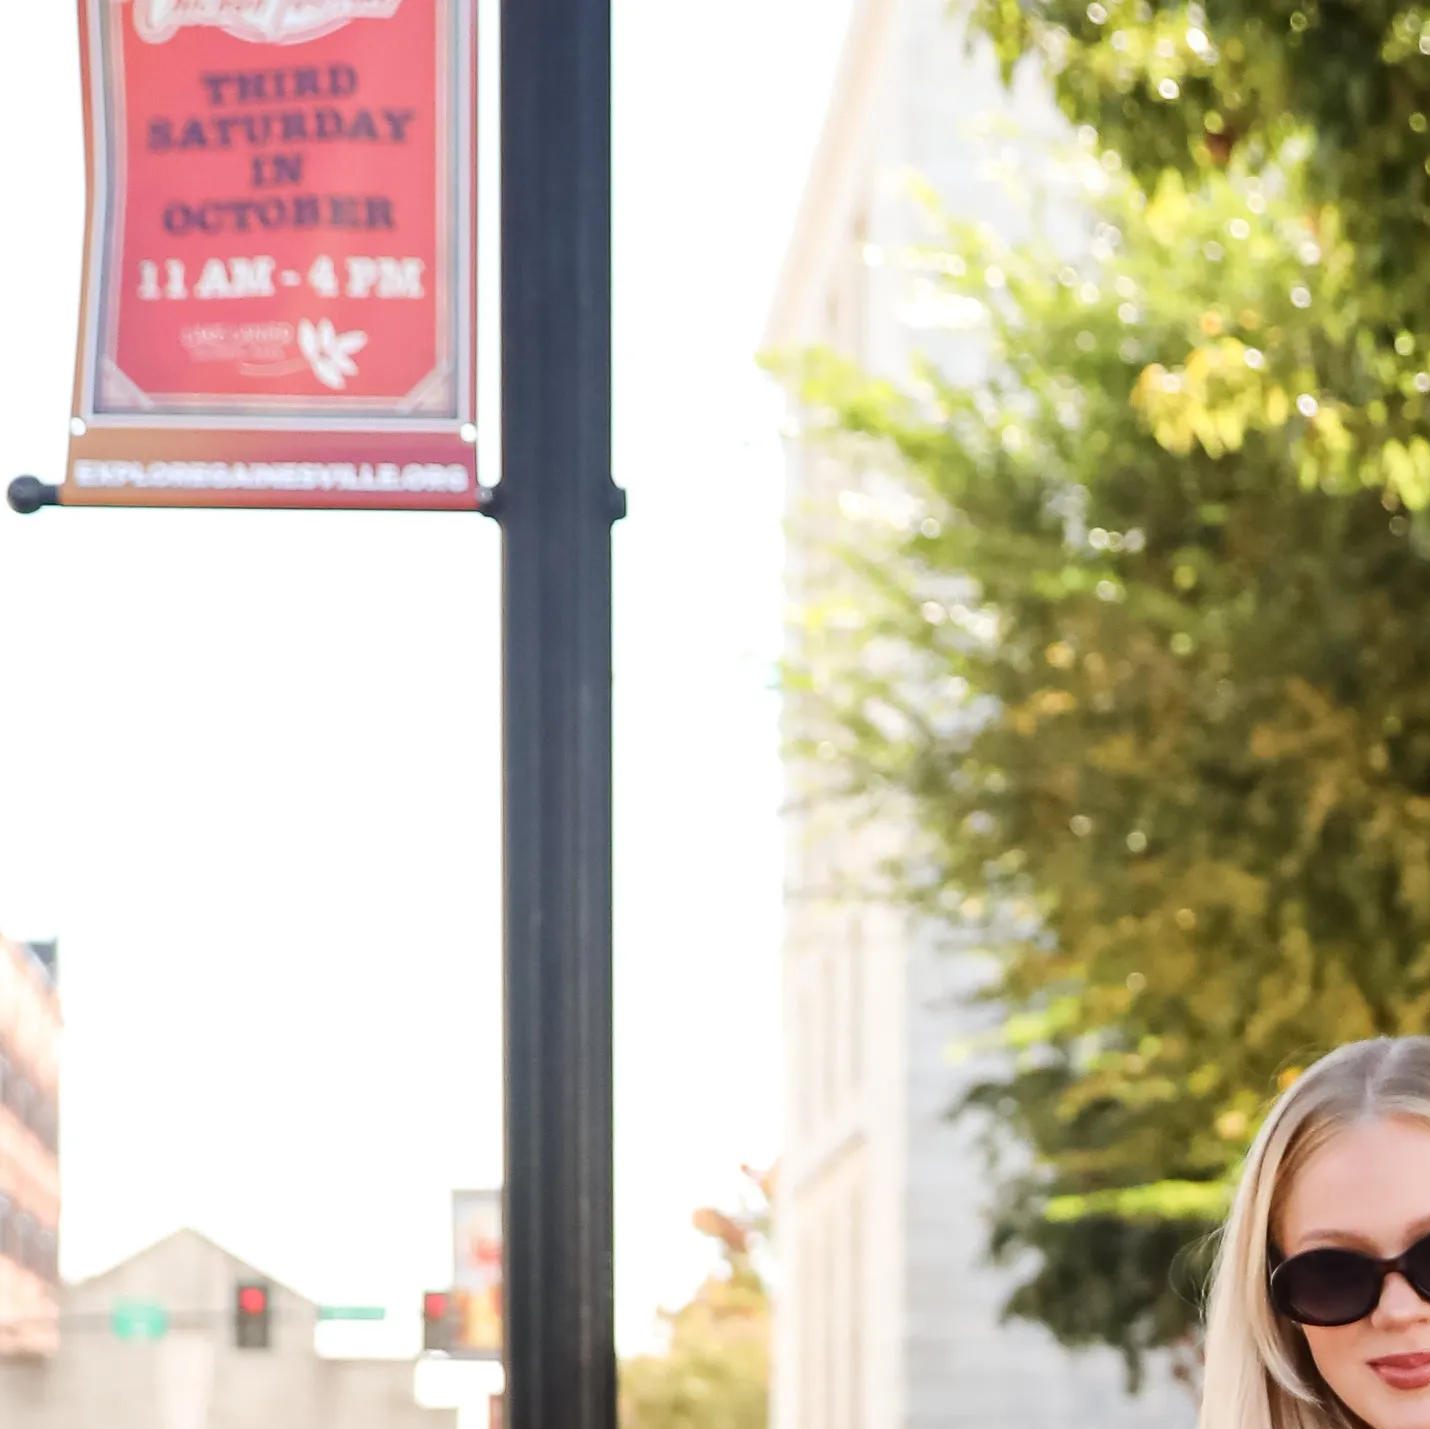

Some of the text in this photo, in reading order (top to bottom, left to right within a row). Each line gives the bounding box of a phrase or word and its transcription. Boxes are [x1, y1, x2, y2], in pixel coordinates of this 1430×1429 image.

[203, 65, 357, 104] THIRD
[147, 110, 414, 150] SATURDAY
[252, 154, 304, 187] IN
[163, 196, 394, 236] OCTOBER
[139, 258, 187, 300] 11
[195, 255, 275, 299] AM
[307, 254, 339, 297] 4
[345, 256, 426, 298] PM
